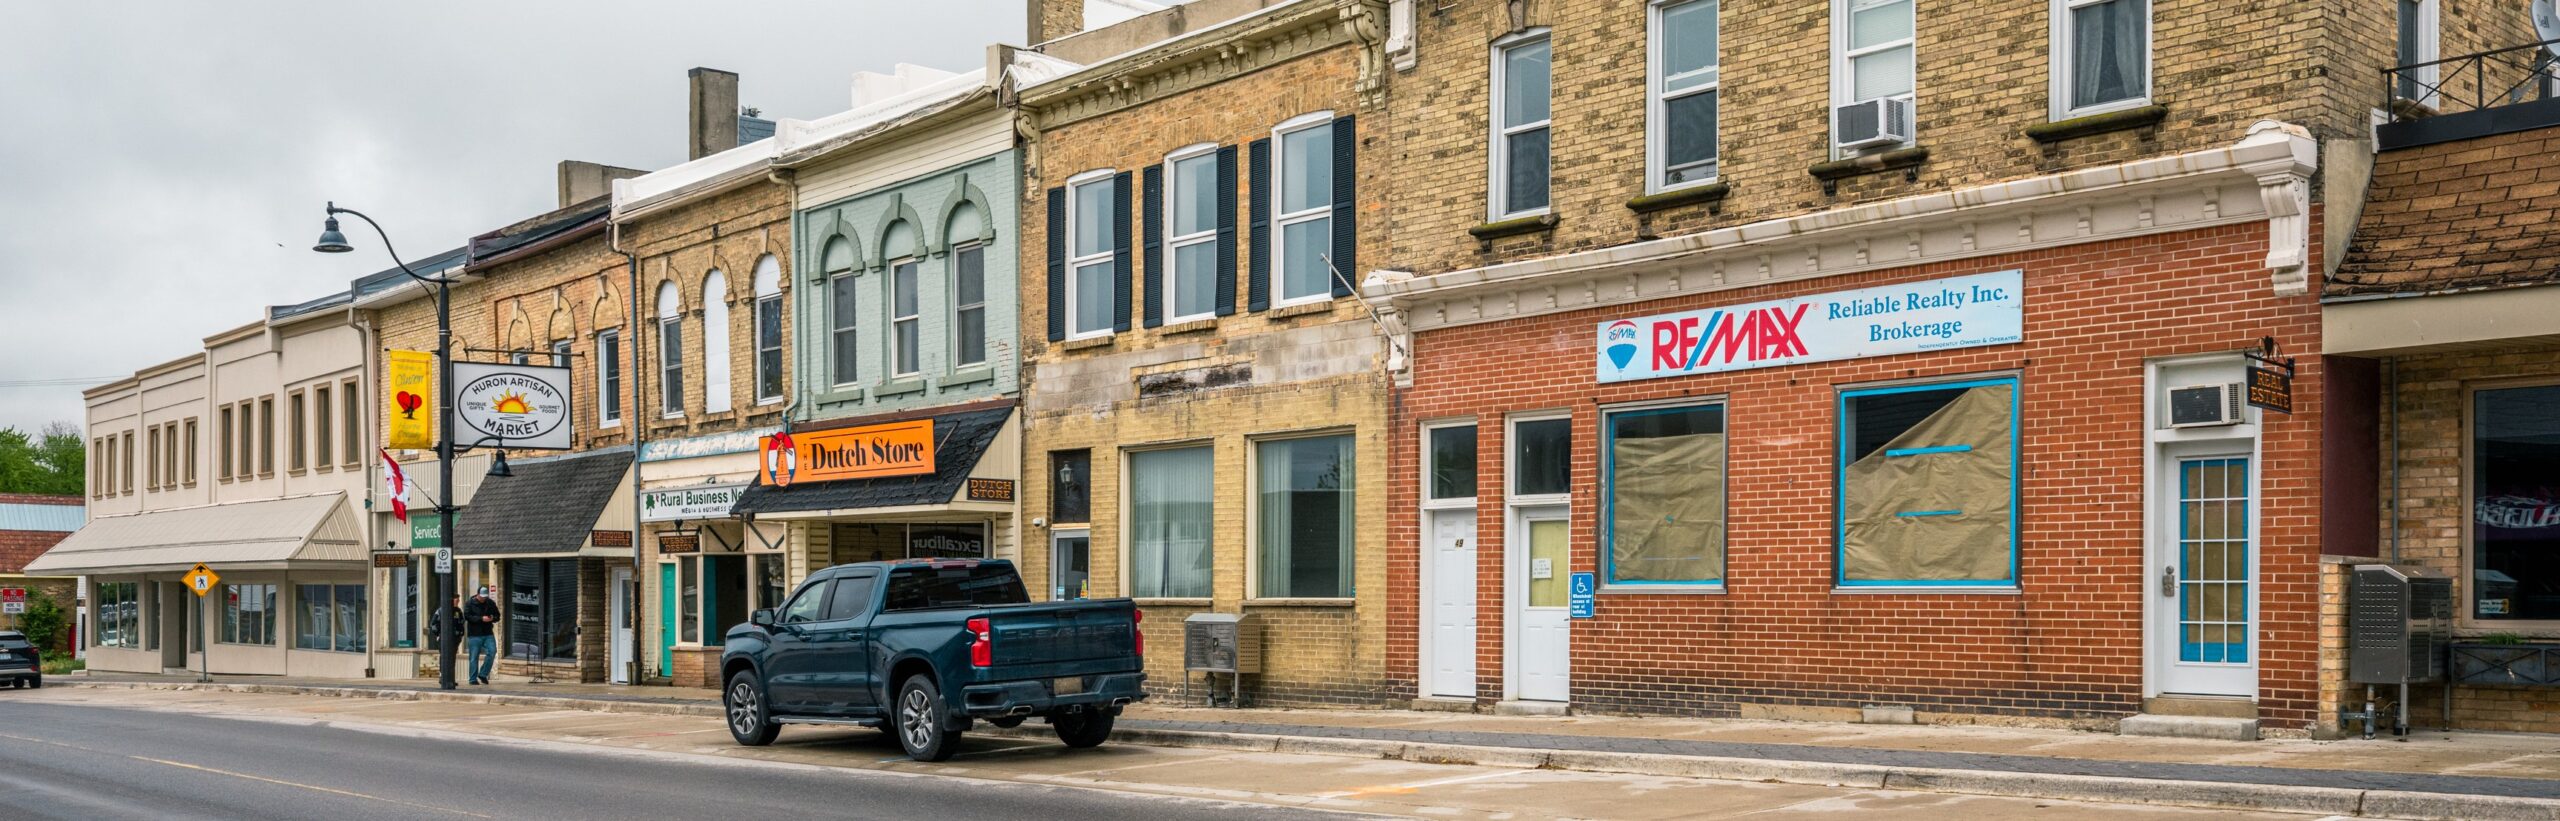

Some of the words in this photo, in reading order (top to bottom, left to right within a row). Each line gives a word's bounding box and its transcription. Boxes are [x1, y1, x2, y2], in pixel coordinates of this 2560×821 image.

[1828, 296, 1900, 320] Reliable
[1906, 289, 1965, 310] Realty
[1971, 285, 2008, 303] Inc.
[1608, 326, 1636, 342] RE/MAX
[1652, 303, 1810, 371] RE/MAX
[1869, 320, 1962, 342] Brokerage
[472, 378, 507, 395] HURON
[510, 377, 553, 398] ARTISAN
[2256, 371, 2283, 390] REAL
[2250, 386, 2289, 408] ESTATE
[484, 418, 540, 435] MARKET
[811, 439, 867, 470] Dutch
[871, 436, 924, 465] Store
[970, 480, 1012, 490] DUTCH
[971, 489, 1010, 499] STORE
[660, 491, 683, 507] Rural
[686, 489, 728, 506] Business
[661, 536, 698, 544] WEBSITE
[665, 543, 694, 552] DESIGN
